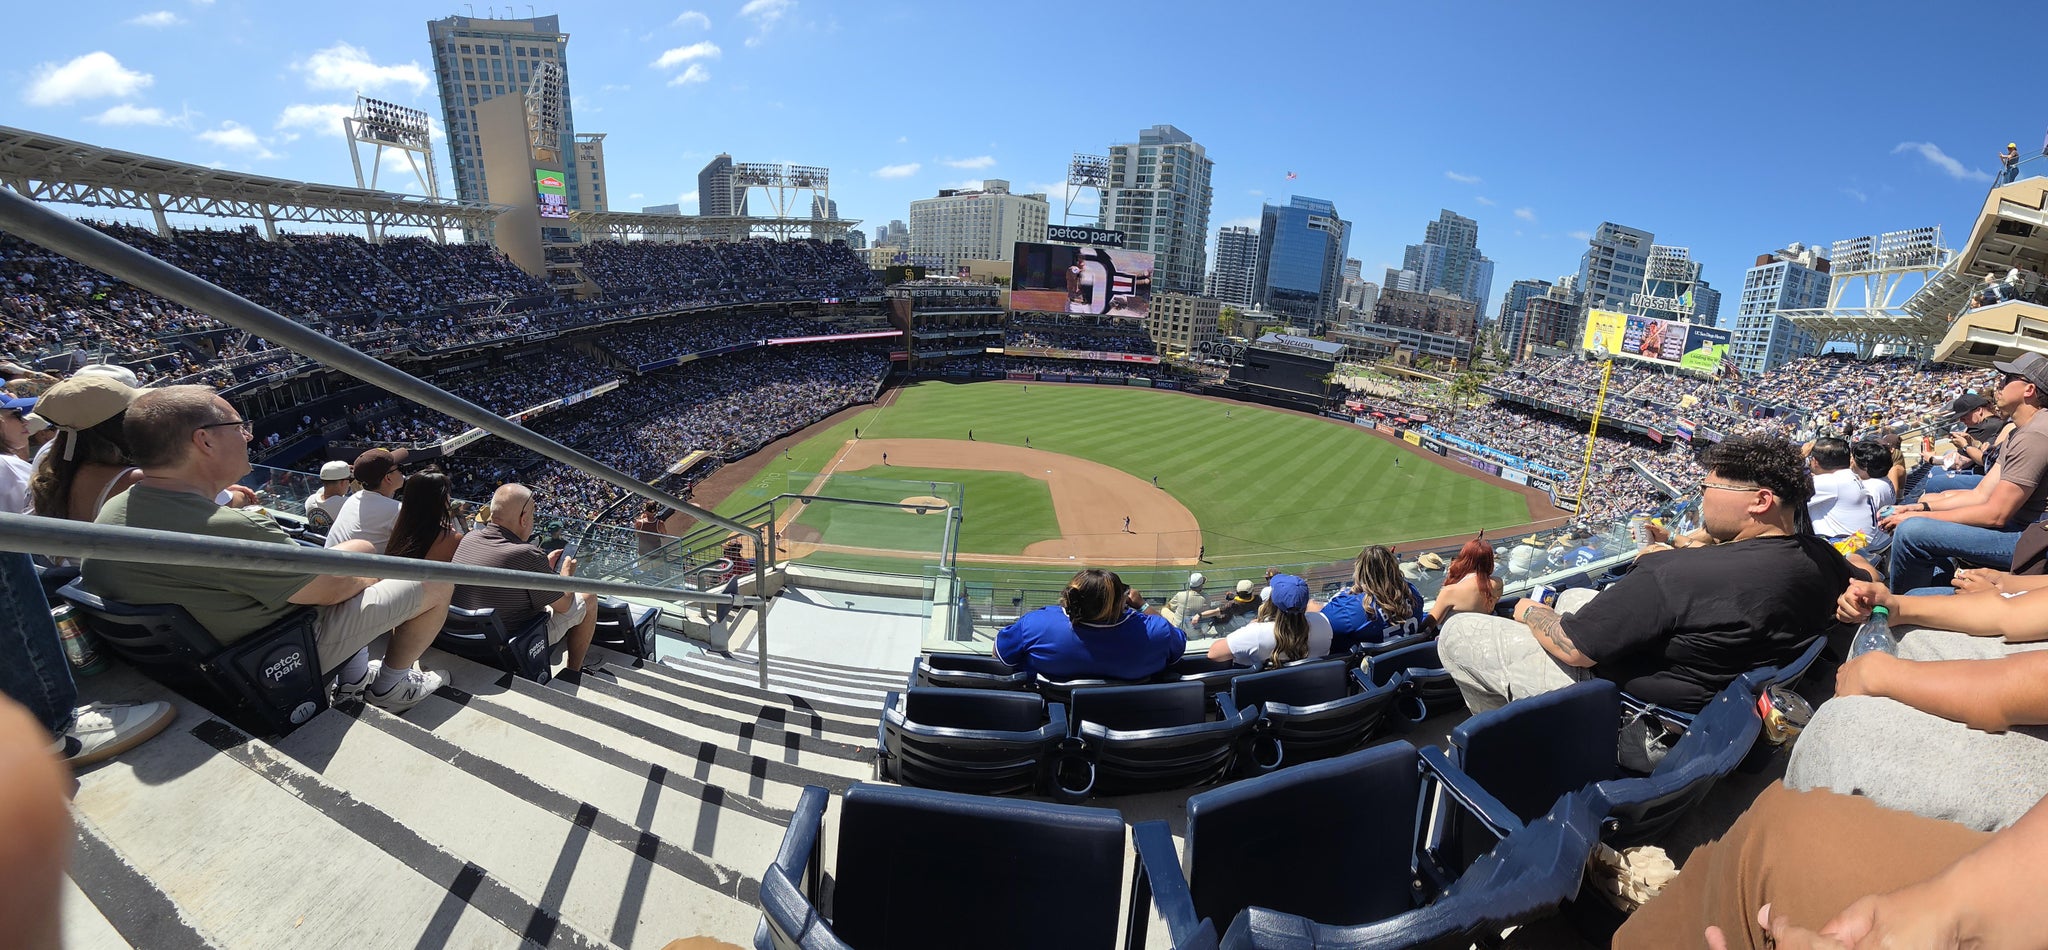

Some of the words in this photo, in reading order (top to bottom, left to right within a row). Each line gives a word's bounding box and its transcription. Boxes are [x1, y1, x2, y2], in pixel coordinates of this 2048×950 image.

[1048, 226, 1088, 240] petco
[1091, 231, 1123, 243] park
[911, 289, 943, 297] WESTERN
[946, 289, 966, 297] METAL
[1632, 293, 1673, 311] Viasat
[1274, 333, 1314, 349] Sycuan
[529, 639, 545, 656] petco
[533, 645, 545, 659] park
[265, 652, 300, 678] petco
[274, 659, 302, 681] park
